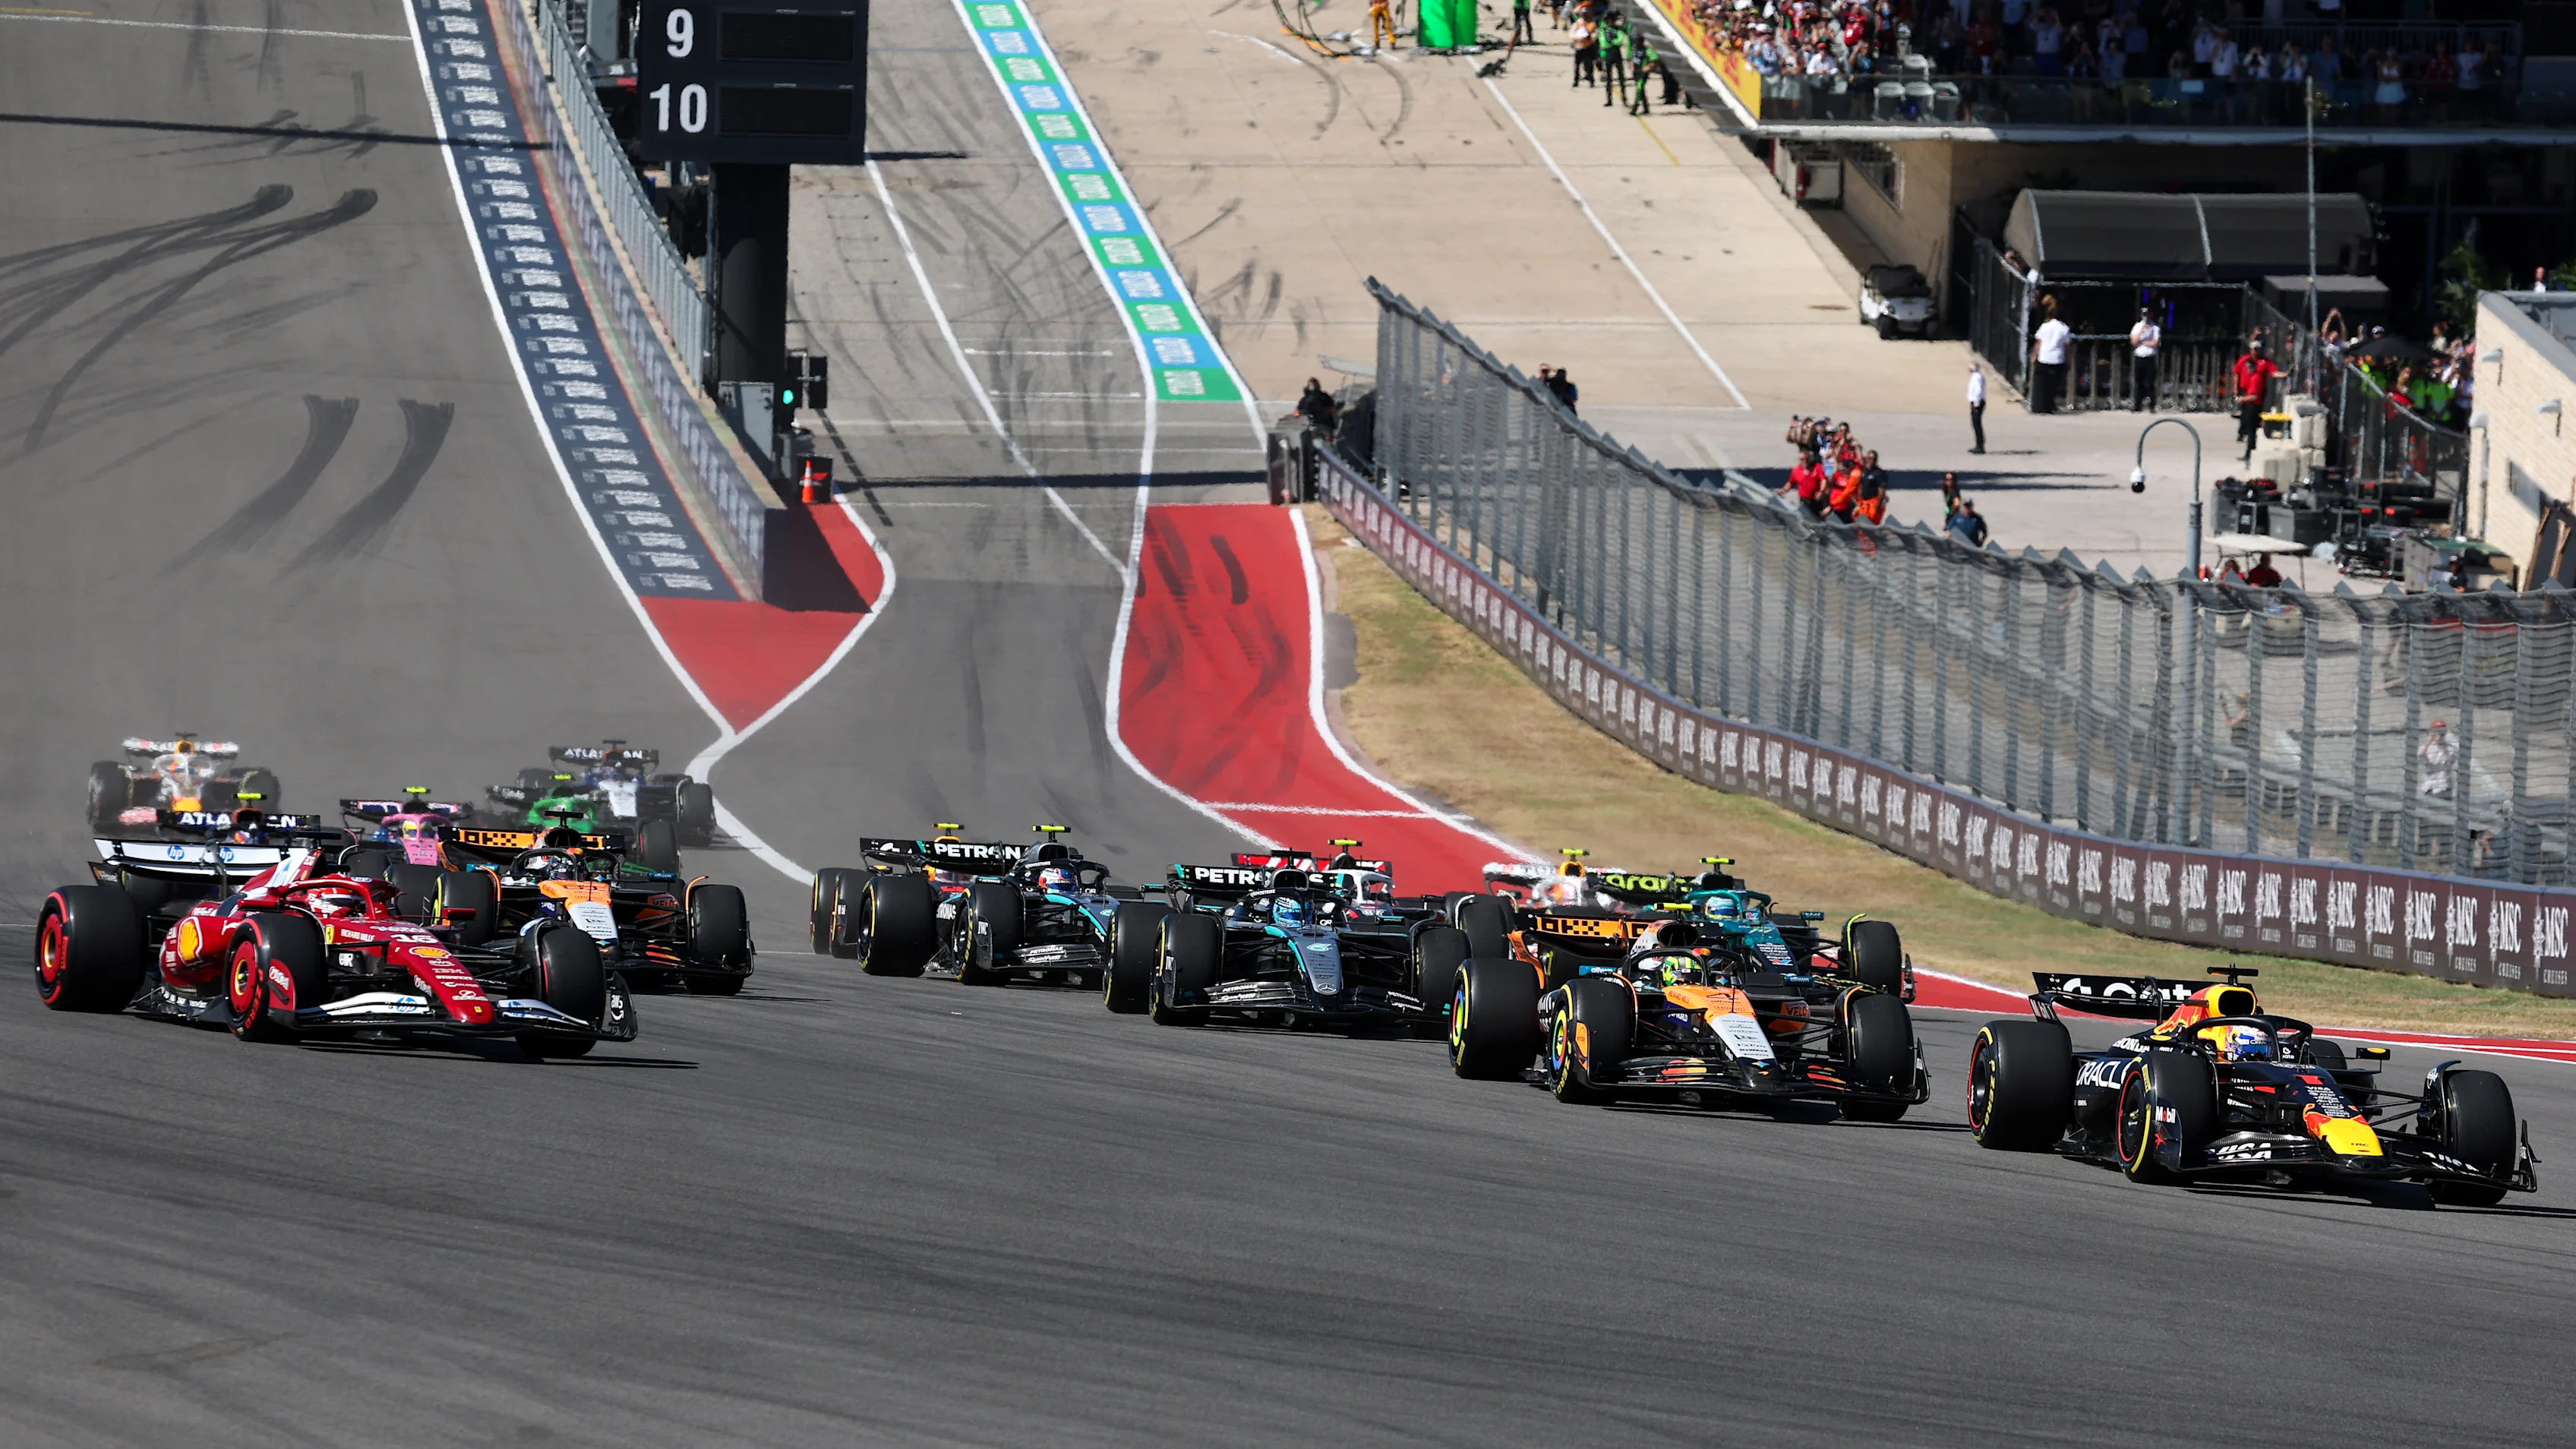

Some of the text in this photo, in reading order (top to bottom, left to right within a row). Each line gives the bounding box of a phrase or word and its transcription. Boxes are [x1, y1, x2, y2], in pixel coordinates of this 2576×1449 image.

[667, 8, 694, 57] 9
[649, 83, 708, 133] 10
[168, 844, 185, 860] hp
[933, 841, 1021, 860] PETRON
[2297, 877, 2317, 925] MSC
[2336, 880, 2357, 929] MSC
[2374, 885, 2394, 935] MSC
[2414, 890, 2436, 941] MSC
[2456, 895, 2477, 947] MSC
[977, 921, 989, 936] IWC
[2499, 900, 2521, 954] MSC
[2544, 906, 2568, 958] MSC
[390, 933, 439, 944] 16
[1029, 946, 1064, 955] PETRONAS
[2413, 949, 2435, 967] CRUISES
[2454, 955, 2477, 972] CRUISES
[2499, 961, 2521, 980] CRUISES
[2543, 968, 2568, 985] CRUISES
[1222, 984, 1258, 993] PETRONAS
[611, 994, 623, 1009] aws
[1786, 1006, 1809, 1017] VELO
[2113, 1037, 2151, 1053] HONDA
[1557, 1056, 1571, 1094] ZERO
[1984, 1075, 1996, 1127] ZERO
[2155, 1106, 2177, 1124] Mobil
